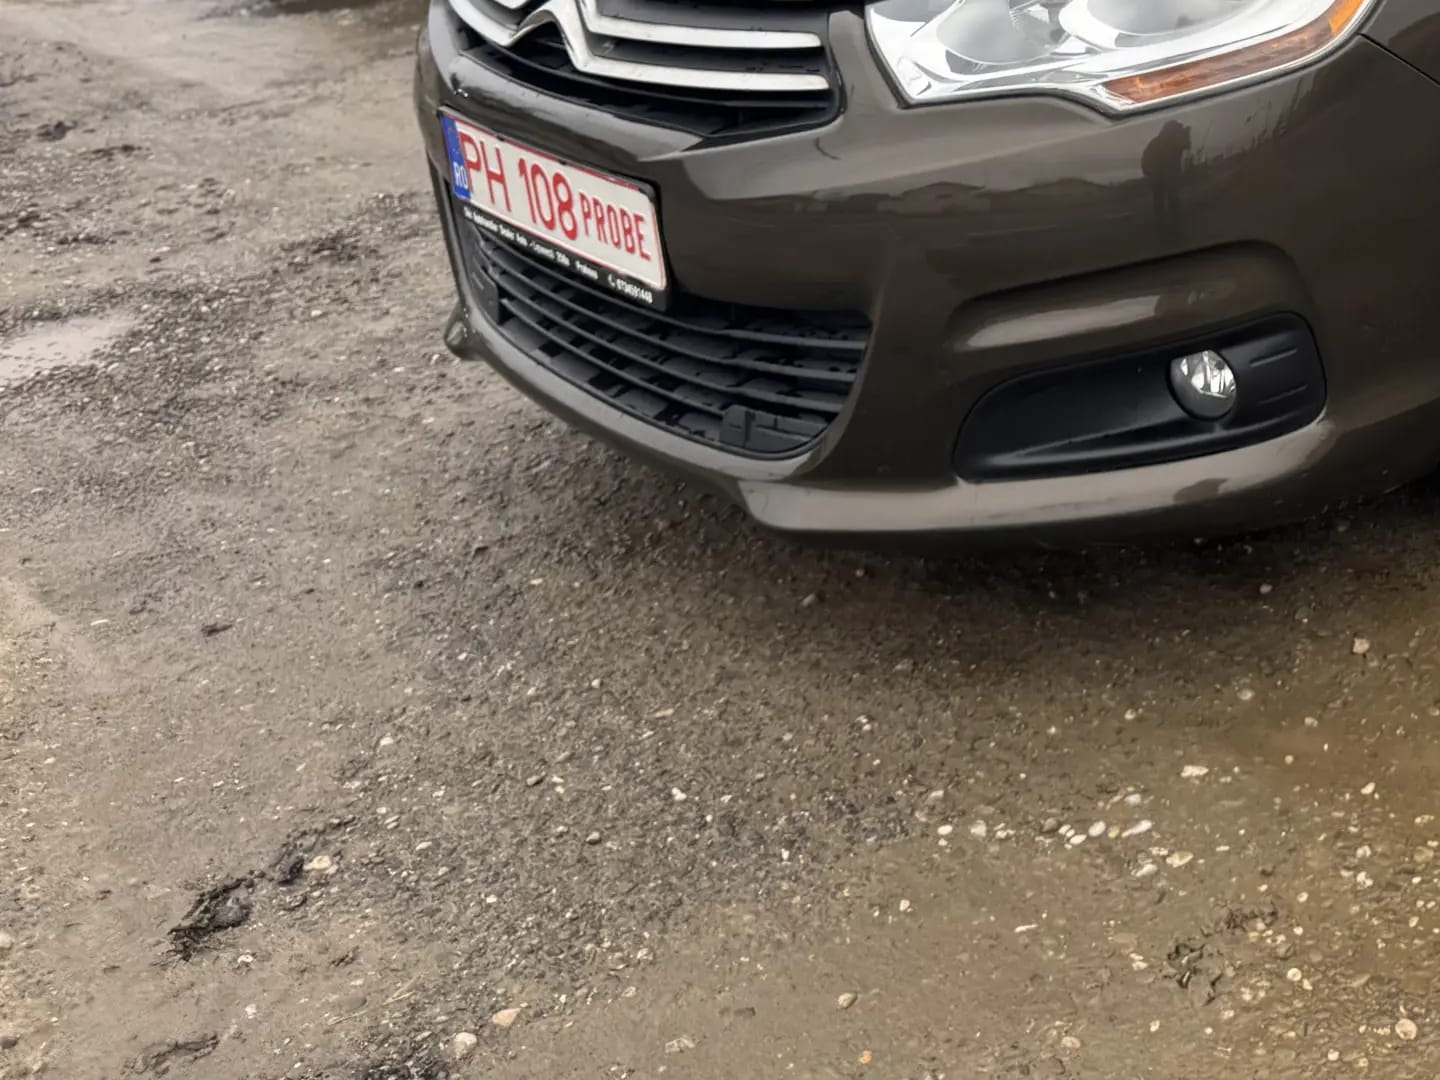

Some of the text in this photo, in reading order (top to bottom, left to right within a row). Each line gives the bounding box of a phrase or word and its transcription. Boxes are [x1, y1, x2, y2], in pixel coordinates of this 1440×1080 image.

[453, 161, 468, 190] RO
[458, 131, 511, 213] PH
[518, 158, 578, 241] 108
[579, 192, 652, 262] PROBE
